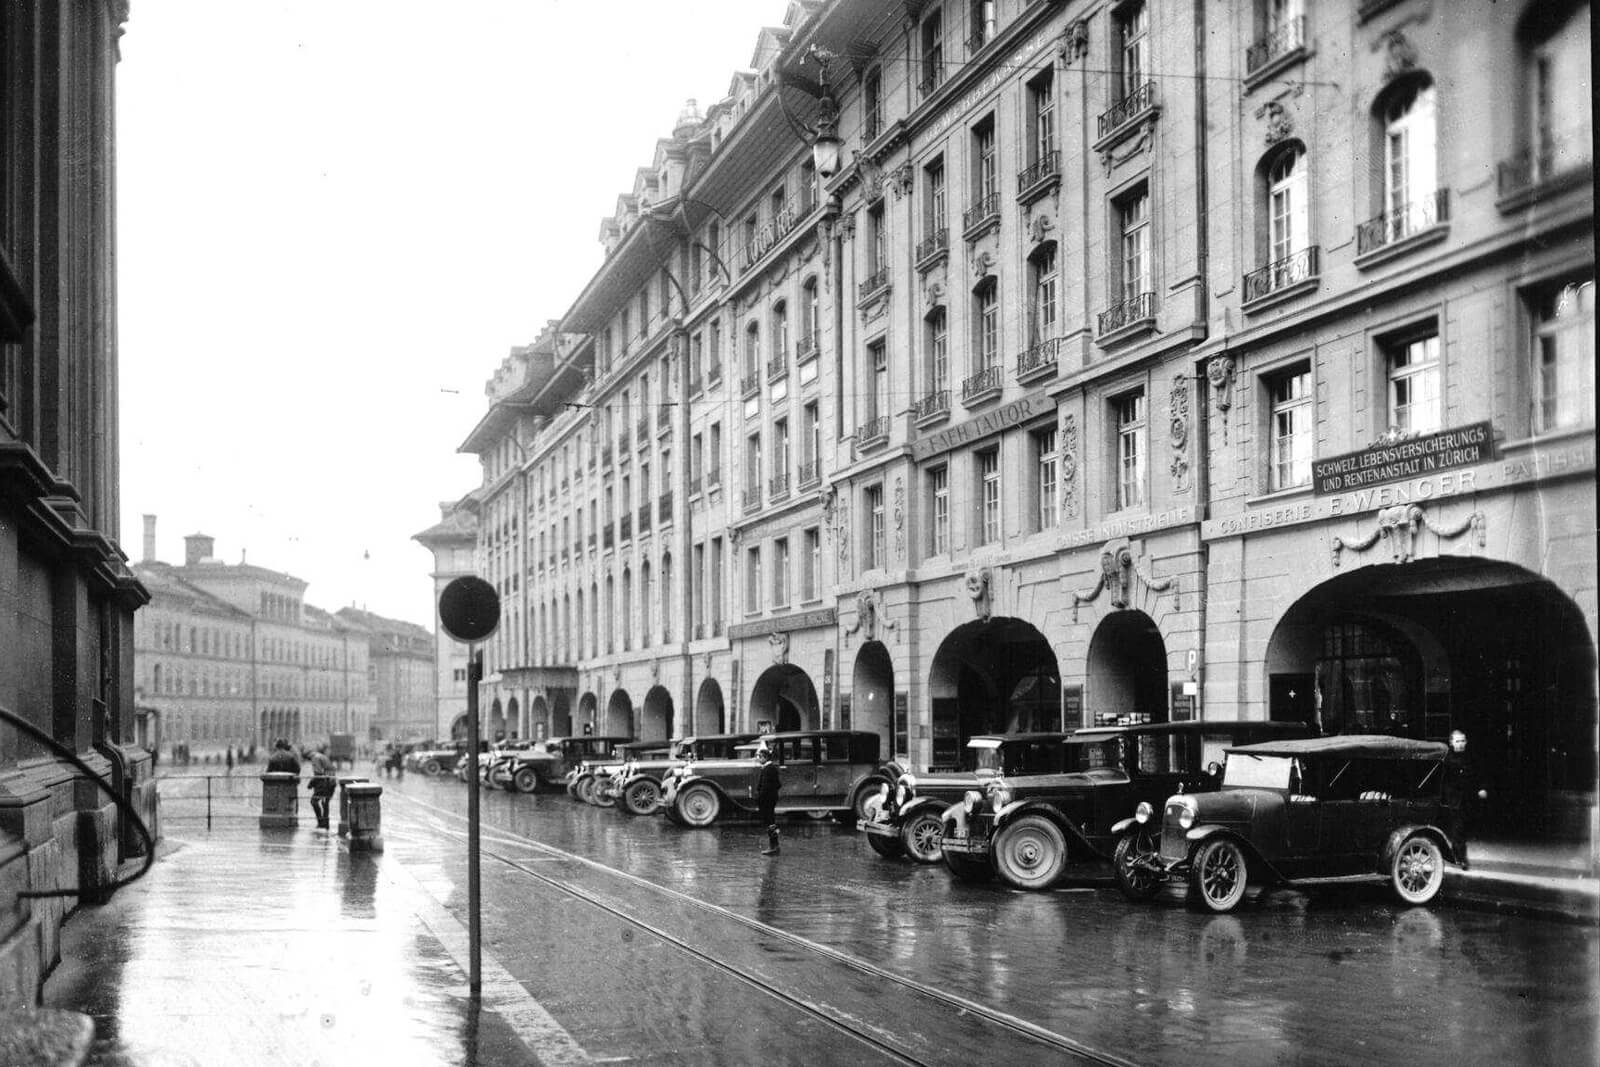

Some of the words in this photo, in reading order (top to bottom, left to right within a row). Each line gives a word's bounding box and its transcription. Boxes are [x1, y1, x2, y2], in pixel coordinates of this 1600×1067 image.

[973, 399, 1034, 437] TAILOR
[1322, 477, 1342, 492] UND
[1344, 459, 1420, 487] RENTENANSTALT
[1424, 456, 1435, 471] IN
[1439, 446, 1480, 468] ZÜRICH
[1218, 505, 1313, 535] CONFISERIE
[1351, 470, 1477, 513] WENGER
[1188, 650, 1197, 672] P
